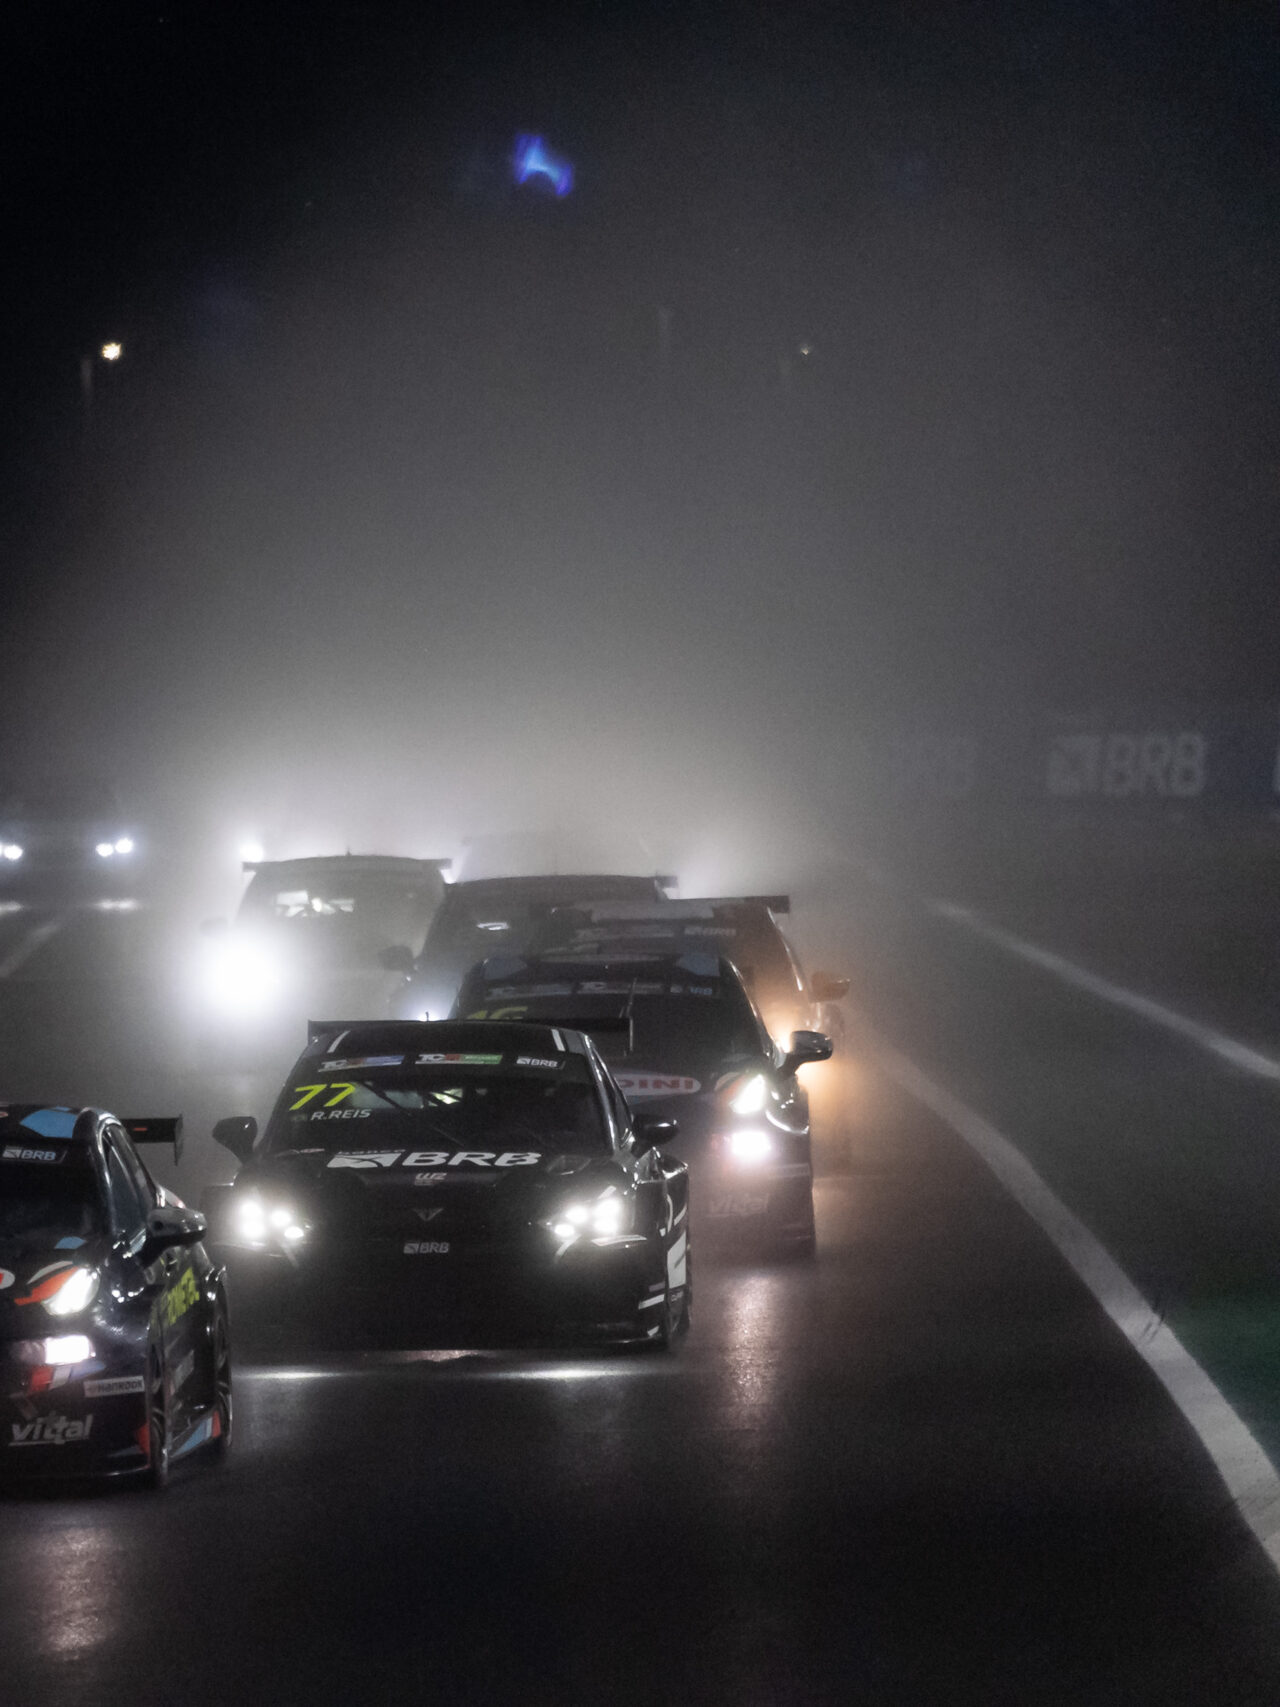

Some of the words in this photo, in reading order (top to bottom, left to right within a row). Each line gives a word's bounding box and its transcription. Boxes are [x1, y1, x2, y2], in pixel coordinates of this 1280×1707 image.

[1102, 732, 1207, 796] BRB
[531, 1058, 558, 1068] BRB
[289, 1083, 356, 1111] 77
[311, 1108, 371, 1121] R.REIS
[21, 1149, 57, 1161] BRB
[402, 1152, 543, 1167] BRB
[419, 1242, 451, 1254] BRB
